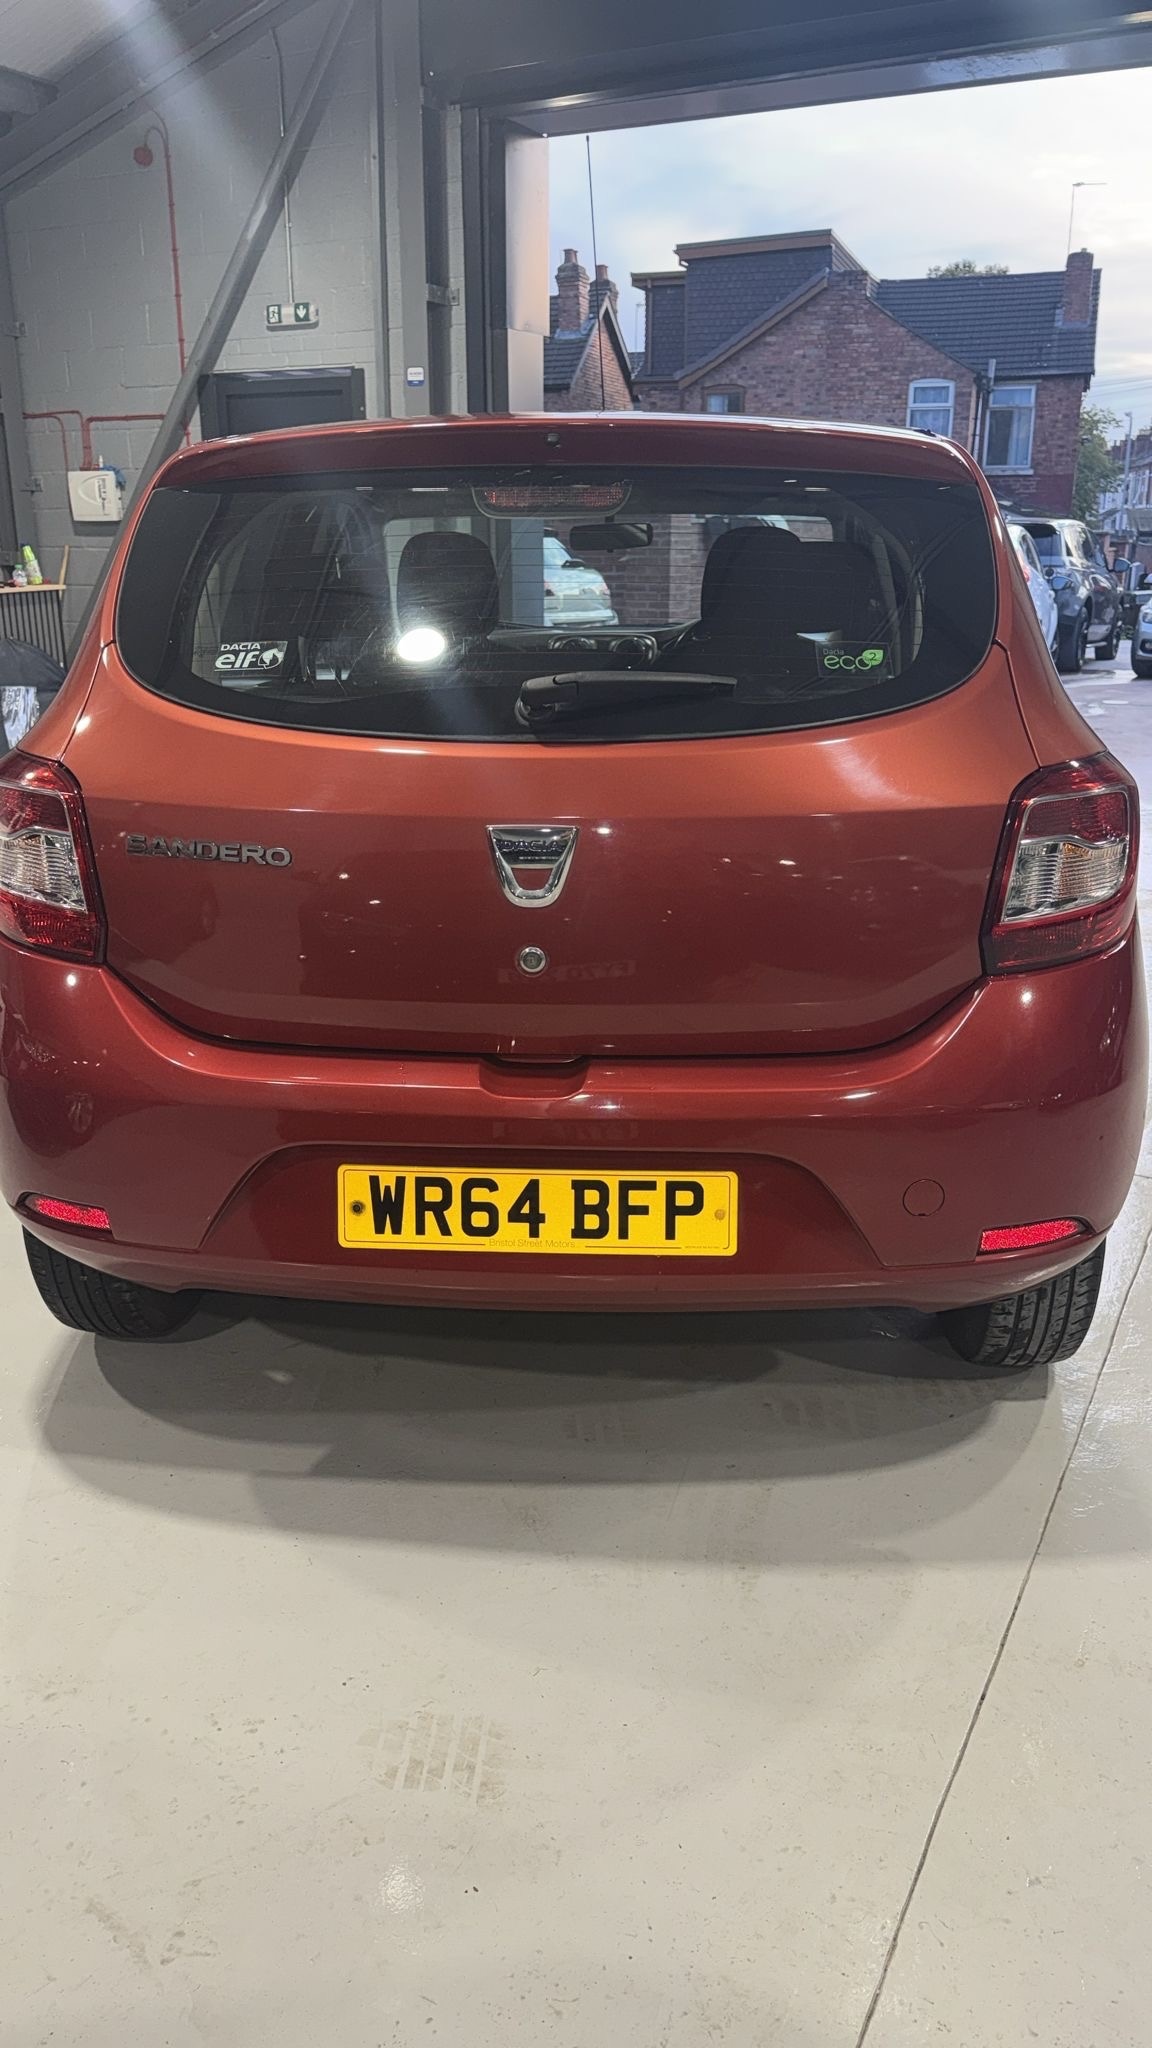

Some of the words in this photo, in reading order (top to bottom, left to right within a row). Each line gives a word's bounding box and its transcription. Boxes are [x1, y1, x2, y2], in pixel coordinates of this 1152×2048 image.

[221, 643, 261, 651] DACIA
[215, 651, 260, 669] elf
[127, 834, 292, 867] SANDERO
[368, 1175, 546, 1238] WR64
[570, 1179, 704, 1240] BFP
[489, 1239, 516, 1247] Bristol
[518, 1239, 543, 1248] Street
[545, 1240, 576, 1249] Motors
